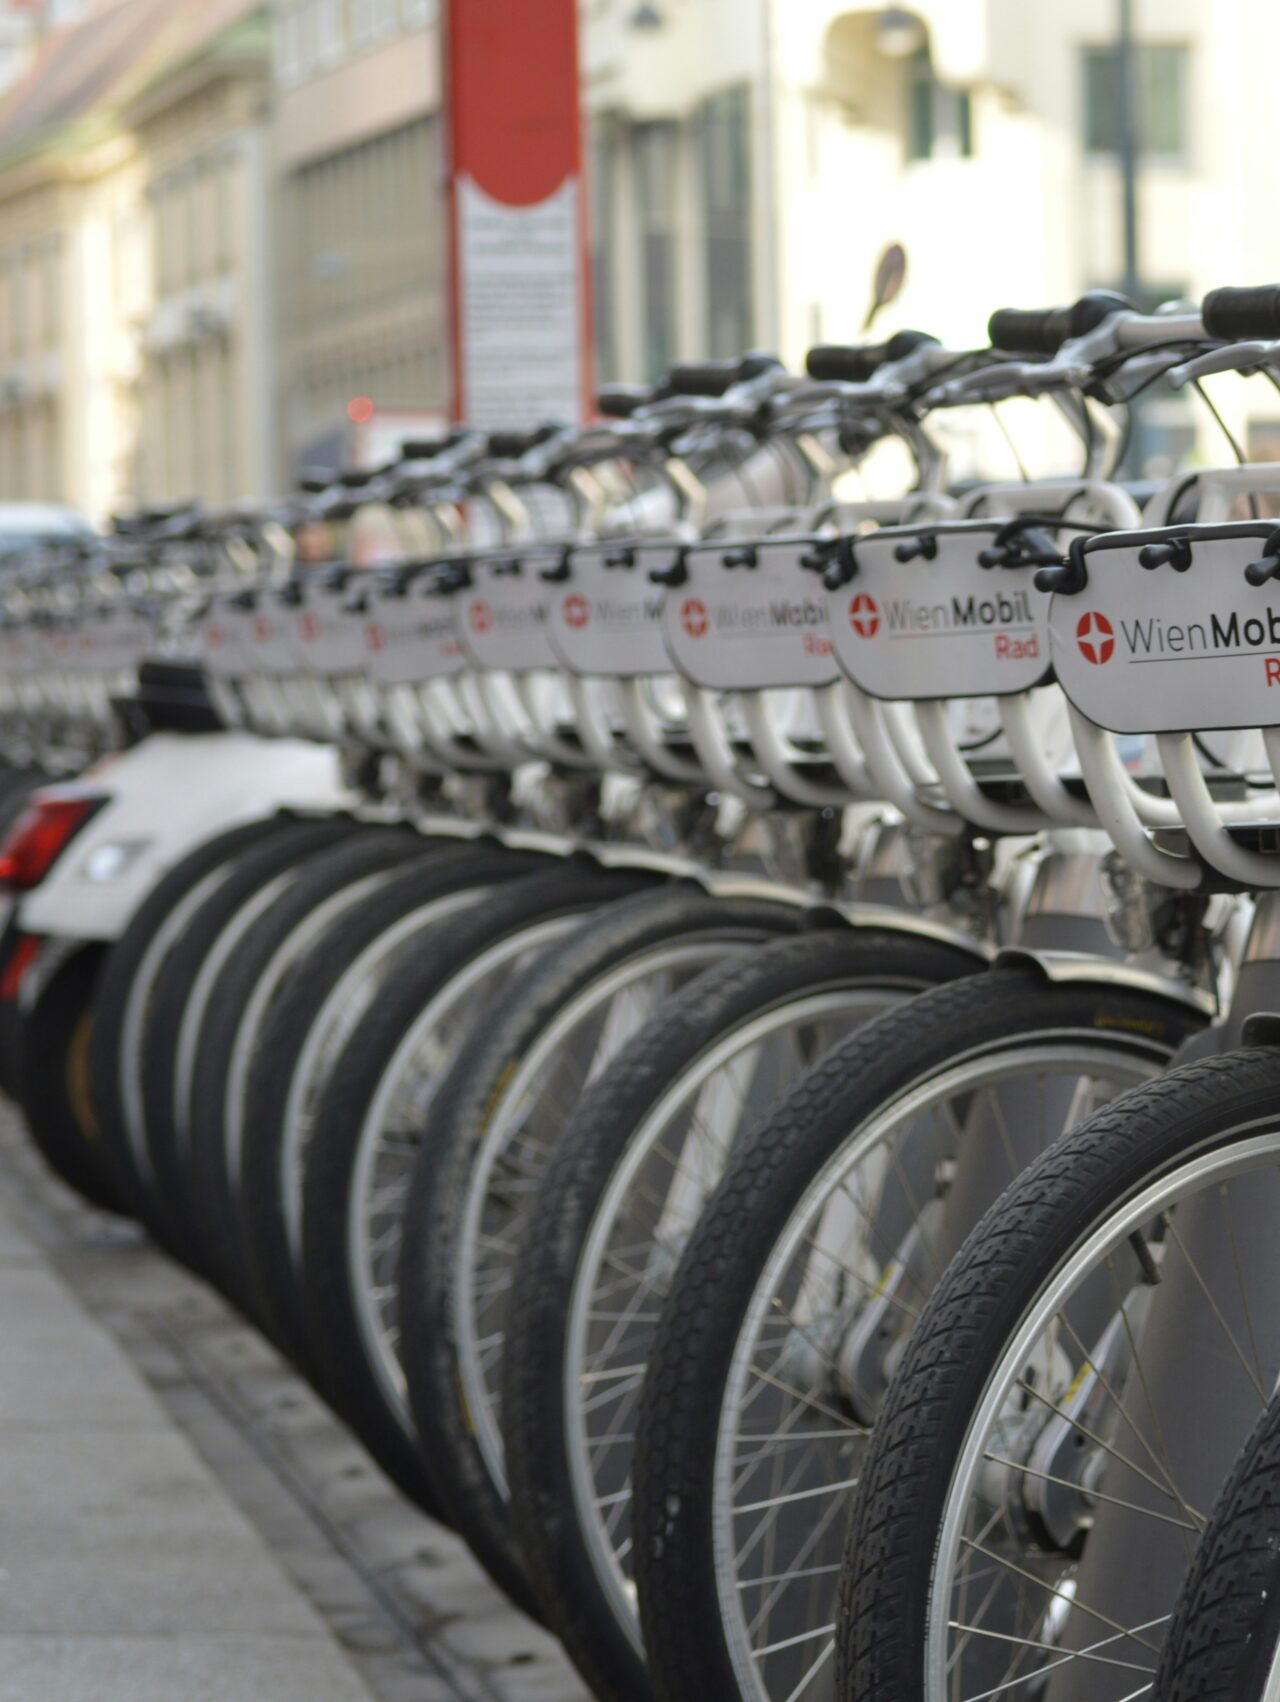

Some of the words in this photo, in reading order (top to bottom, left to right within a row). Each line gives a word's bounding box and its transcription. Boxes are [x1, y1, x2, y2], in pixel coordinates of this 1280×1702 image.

[882, 590, 1035, 630] WienMobil
[804, 632, 834, 656] Ra
[994, 633, 1040, 660] Rad
